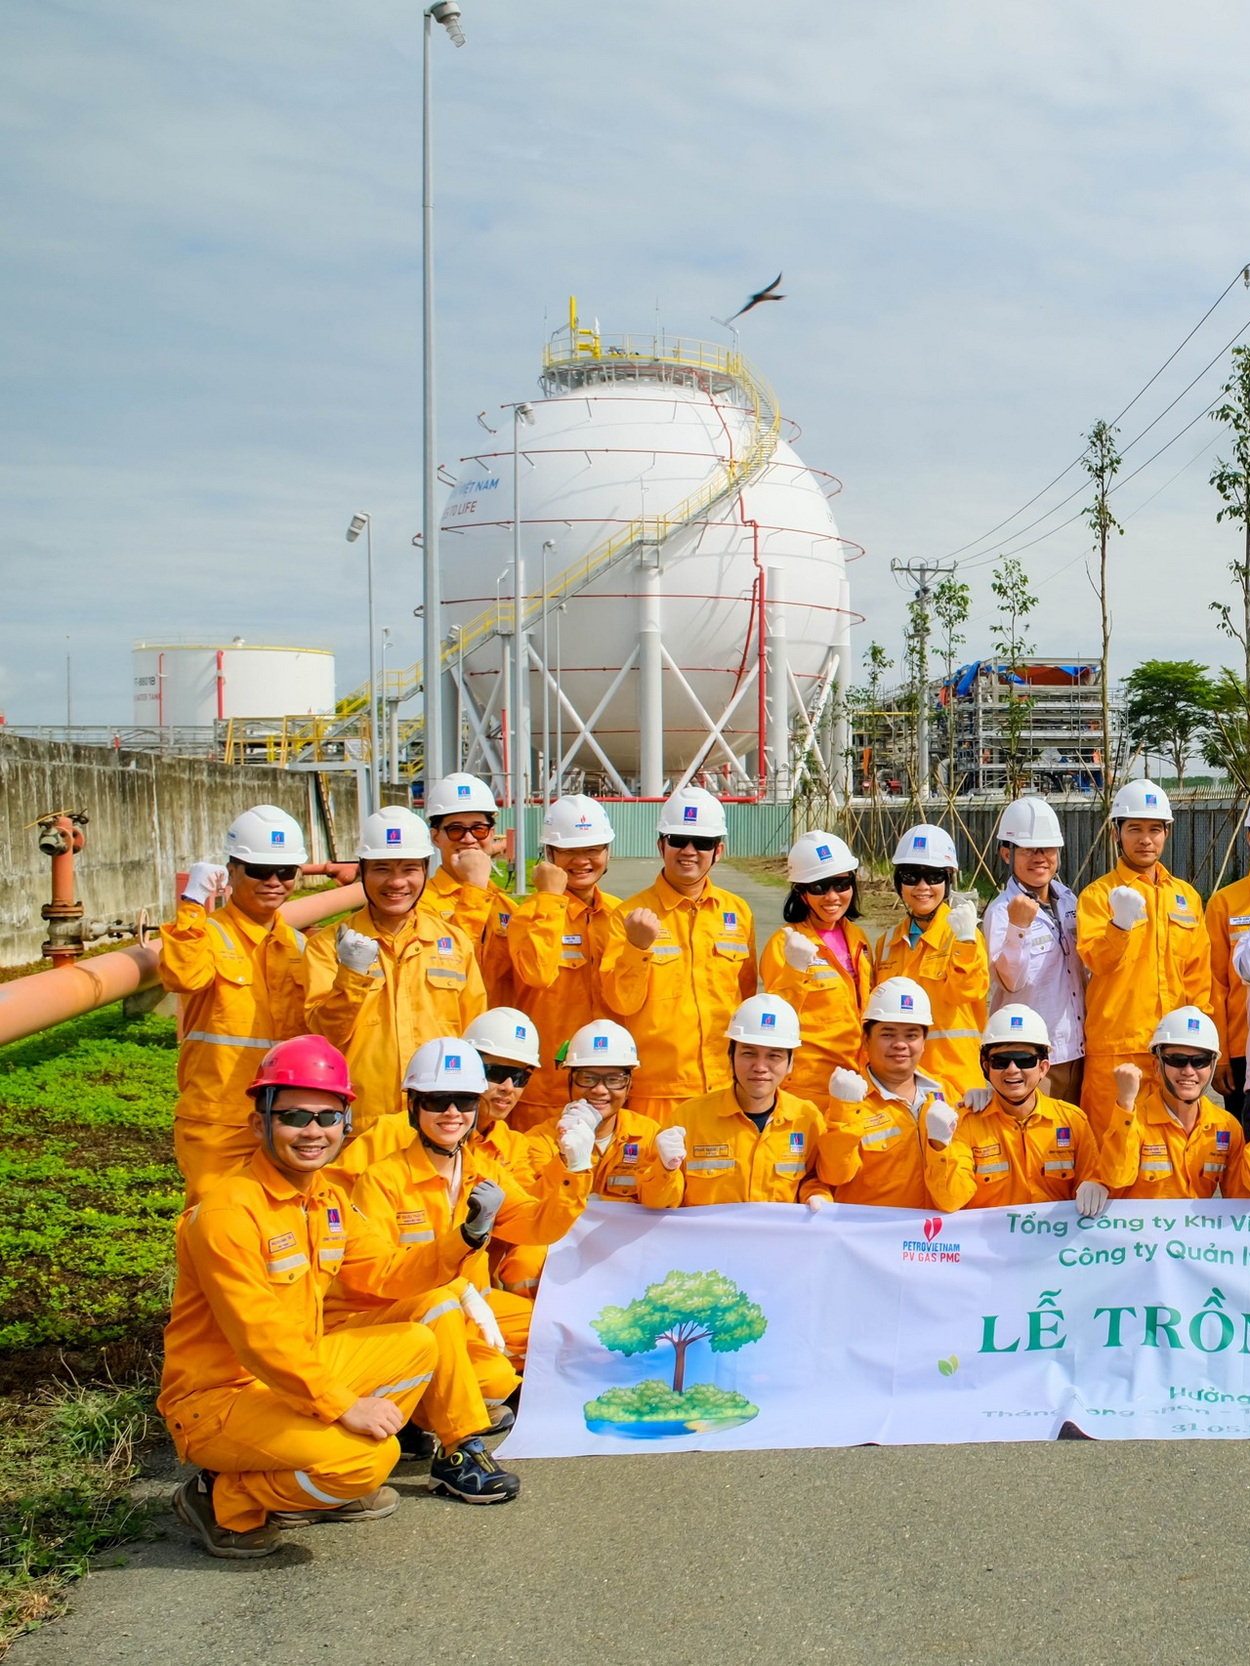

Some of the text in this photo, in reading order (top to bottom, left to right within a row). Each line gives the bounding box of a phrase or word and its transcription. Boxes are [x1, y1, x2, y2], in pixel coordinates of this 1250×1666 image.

[475, 478, 500, 491] NAM
[458, 500, 477, 515] LIFE
[1006, 1211, 1069, 1237] Tổng
[1076, 1215, 1144, 1232] Công
[1152, 1216, 1177, 1231] ty
[1184, 1214, 1222, 1229] Khí
[902, 1240, 961, 1252] PETROVIETNAM
[1058, 1245, 1126, 1267] Công
[1133, 1241, 1159, 1262] ty
[1166, 1239, 1234, 1266] Quản
[902, 1251, 961, 1263] PV GAS PMC
[977, 1288, 1068, 1354] LỄ
